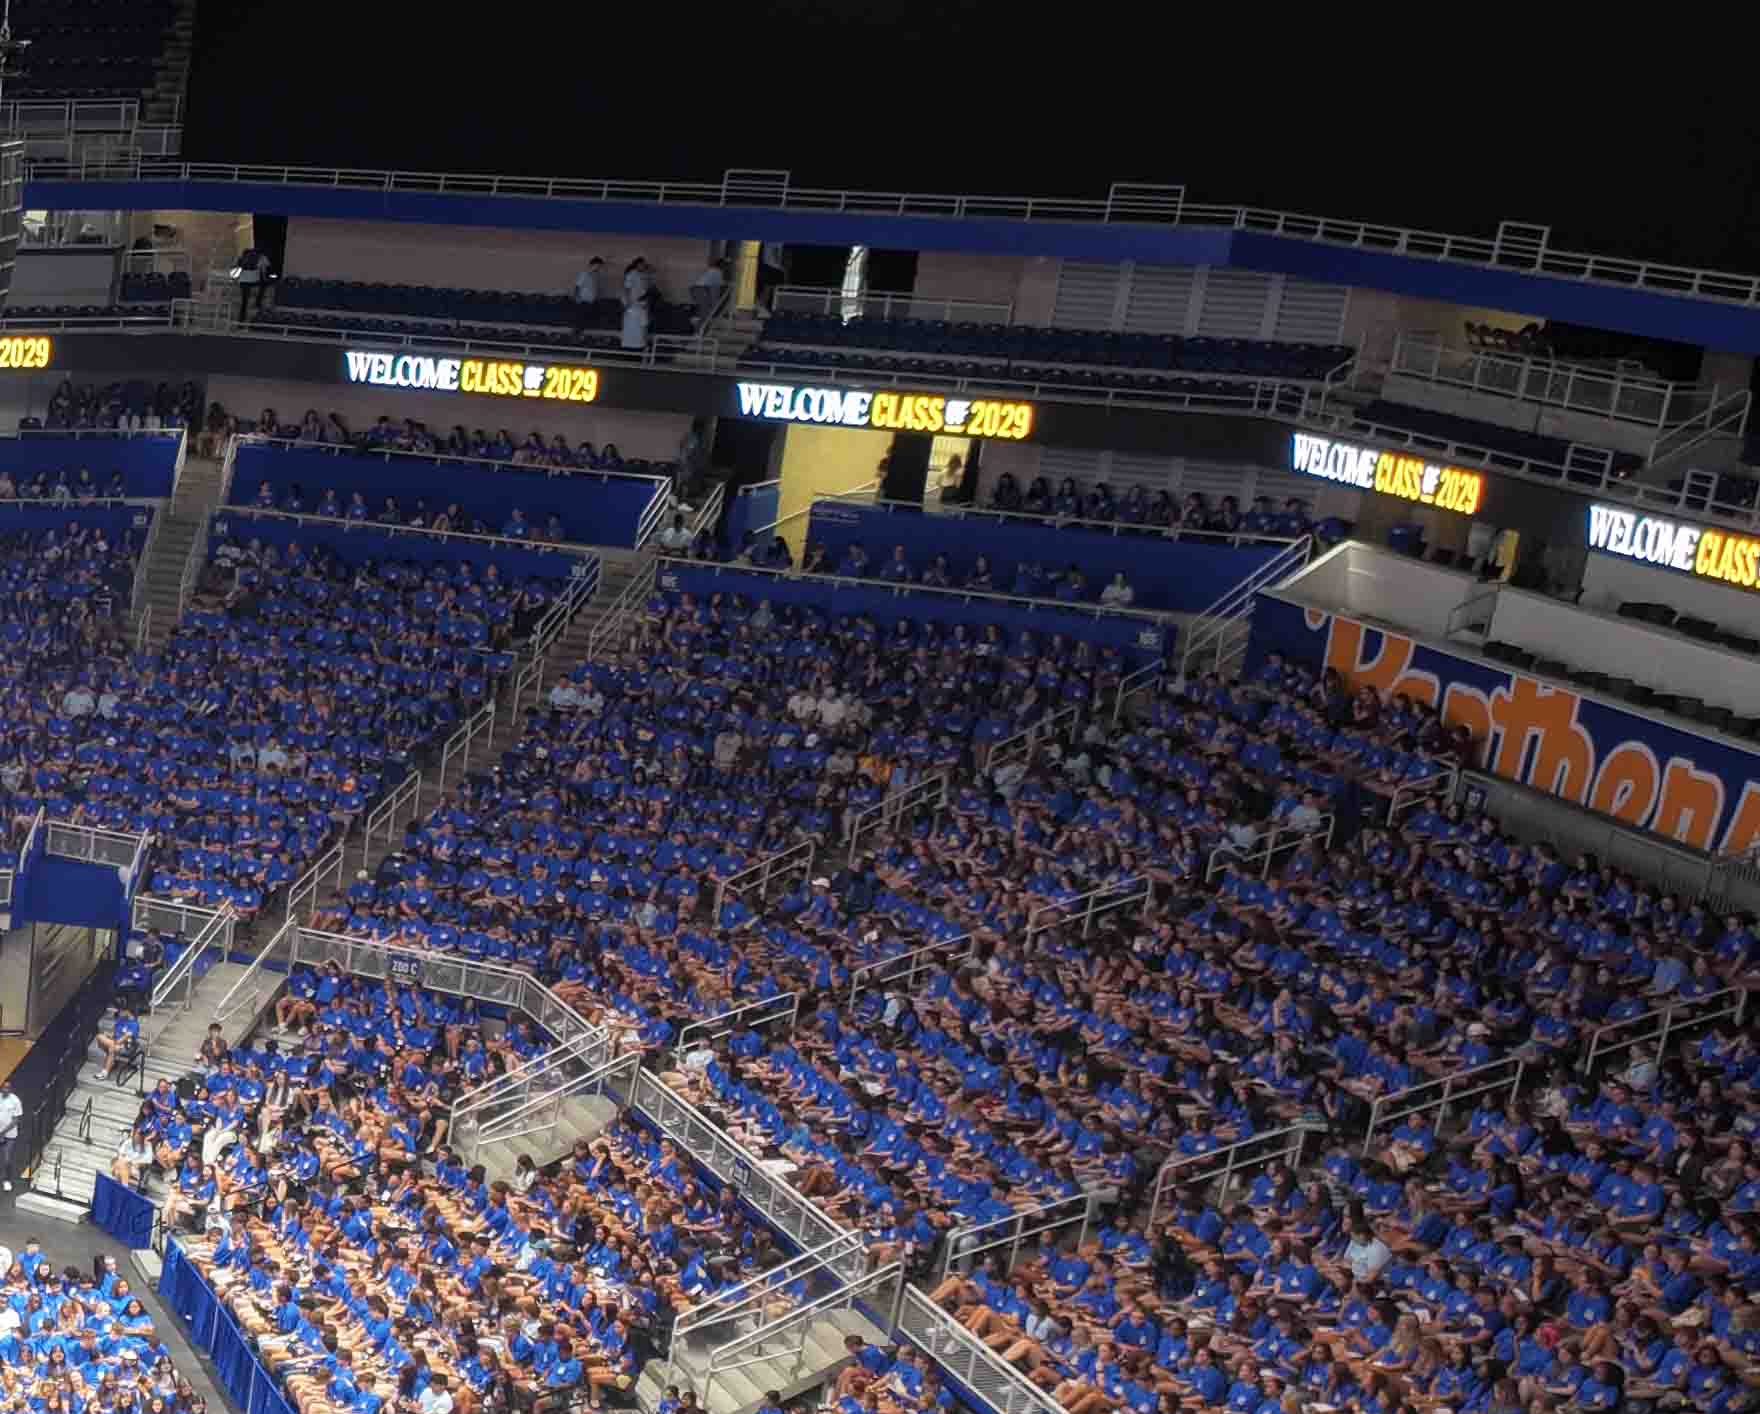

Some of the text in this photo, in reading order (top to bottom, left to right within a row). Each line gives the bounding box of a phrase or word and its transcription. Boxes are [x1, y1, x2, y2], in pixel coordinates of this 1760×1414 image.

[347, 352, 459, 390] WELCOME
[460, 361, 523, 395] CLASS
[544, 367, 597, 401] 2029
[739, 383, 870, 425] WELCOME
[871, 394, 943, 433] CLASS
[969, 401, 1032, 438] 2029
[1294, 434, 1375, 488] WELCOME
[1375, 454, 1422, 497] CLASS
[1437, 468, 1480, 514] 2029
[1590, 505, 1760, 588] WELCOME CLASS
